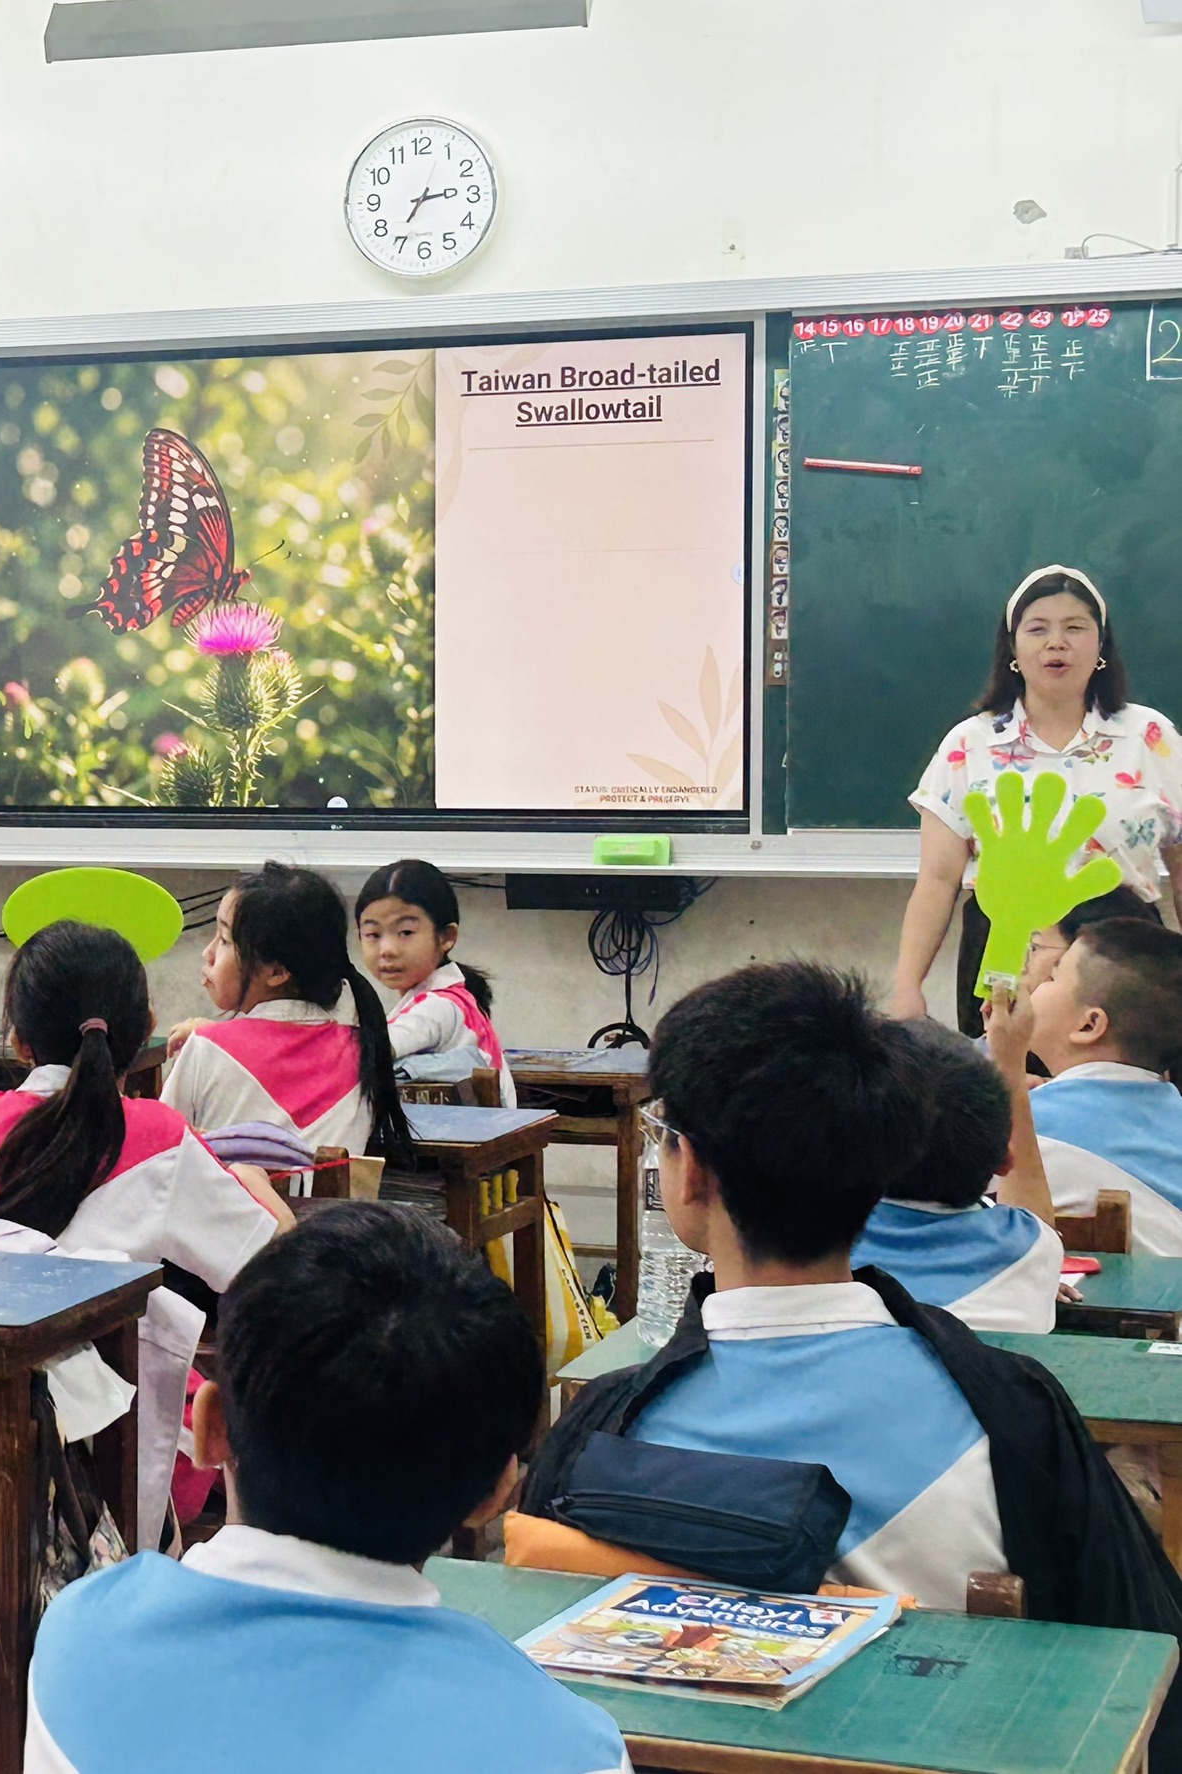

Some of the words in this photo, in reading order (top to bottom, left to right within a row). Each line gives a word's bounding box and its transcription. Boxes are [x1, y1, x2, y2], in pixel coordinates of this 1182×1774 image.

[389, 146, 404, 164] 11
[411, 137, 432, 155] 12
[444, 143, 451, 160] 1
[370, 167, 390, 186] 10
[459, 159, 473, 178] 2
[367, 194, 381, 212] 9
[466, 185, 481, 203] 3
[374, 219, 388, 237] 8
[460, 211, 475, 230] 4
[392, 236, 408, 254] 7
[417, 241, 432, 259] 6
[442, 232, 457, 250] 5
[798, 322, 815, 335] 14
[820, 320, 838, 333] 15
[845, 320, 864, 332] 16
[870, 318, 890, 332] 17
[895, 317, 914, 331] 18
[919, 316, 939, 330] 19
[944, 313, 963, 328] 20
[971, 314, 990, 328] 21
[1001, 313, 1022, 327] 22
[1031, 311, 1052, 325] 23
[1087, 309, 1109, 323] 25
[461, 369, 551, 393] Taiwan
[560, 358, 721, 389] Broad-tailed
[516, 395, 662, 424] Swallowtail
[676, 1595, 804, 1622] Chiayi
[623, 1599, 827, 1637] Adventures
